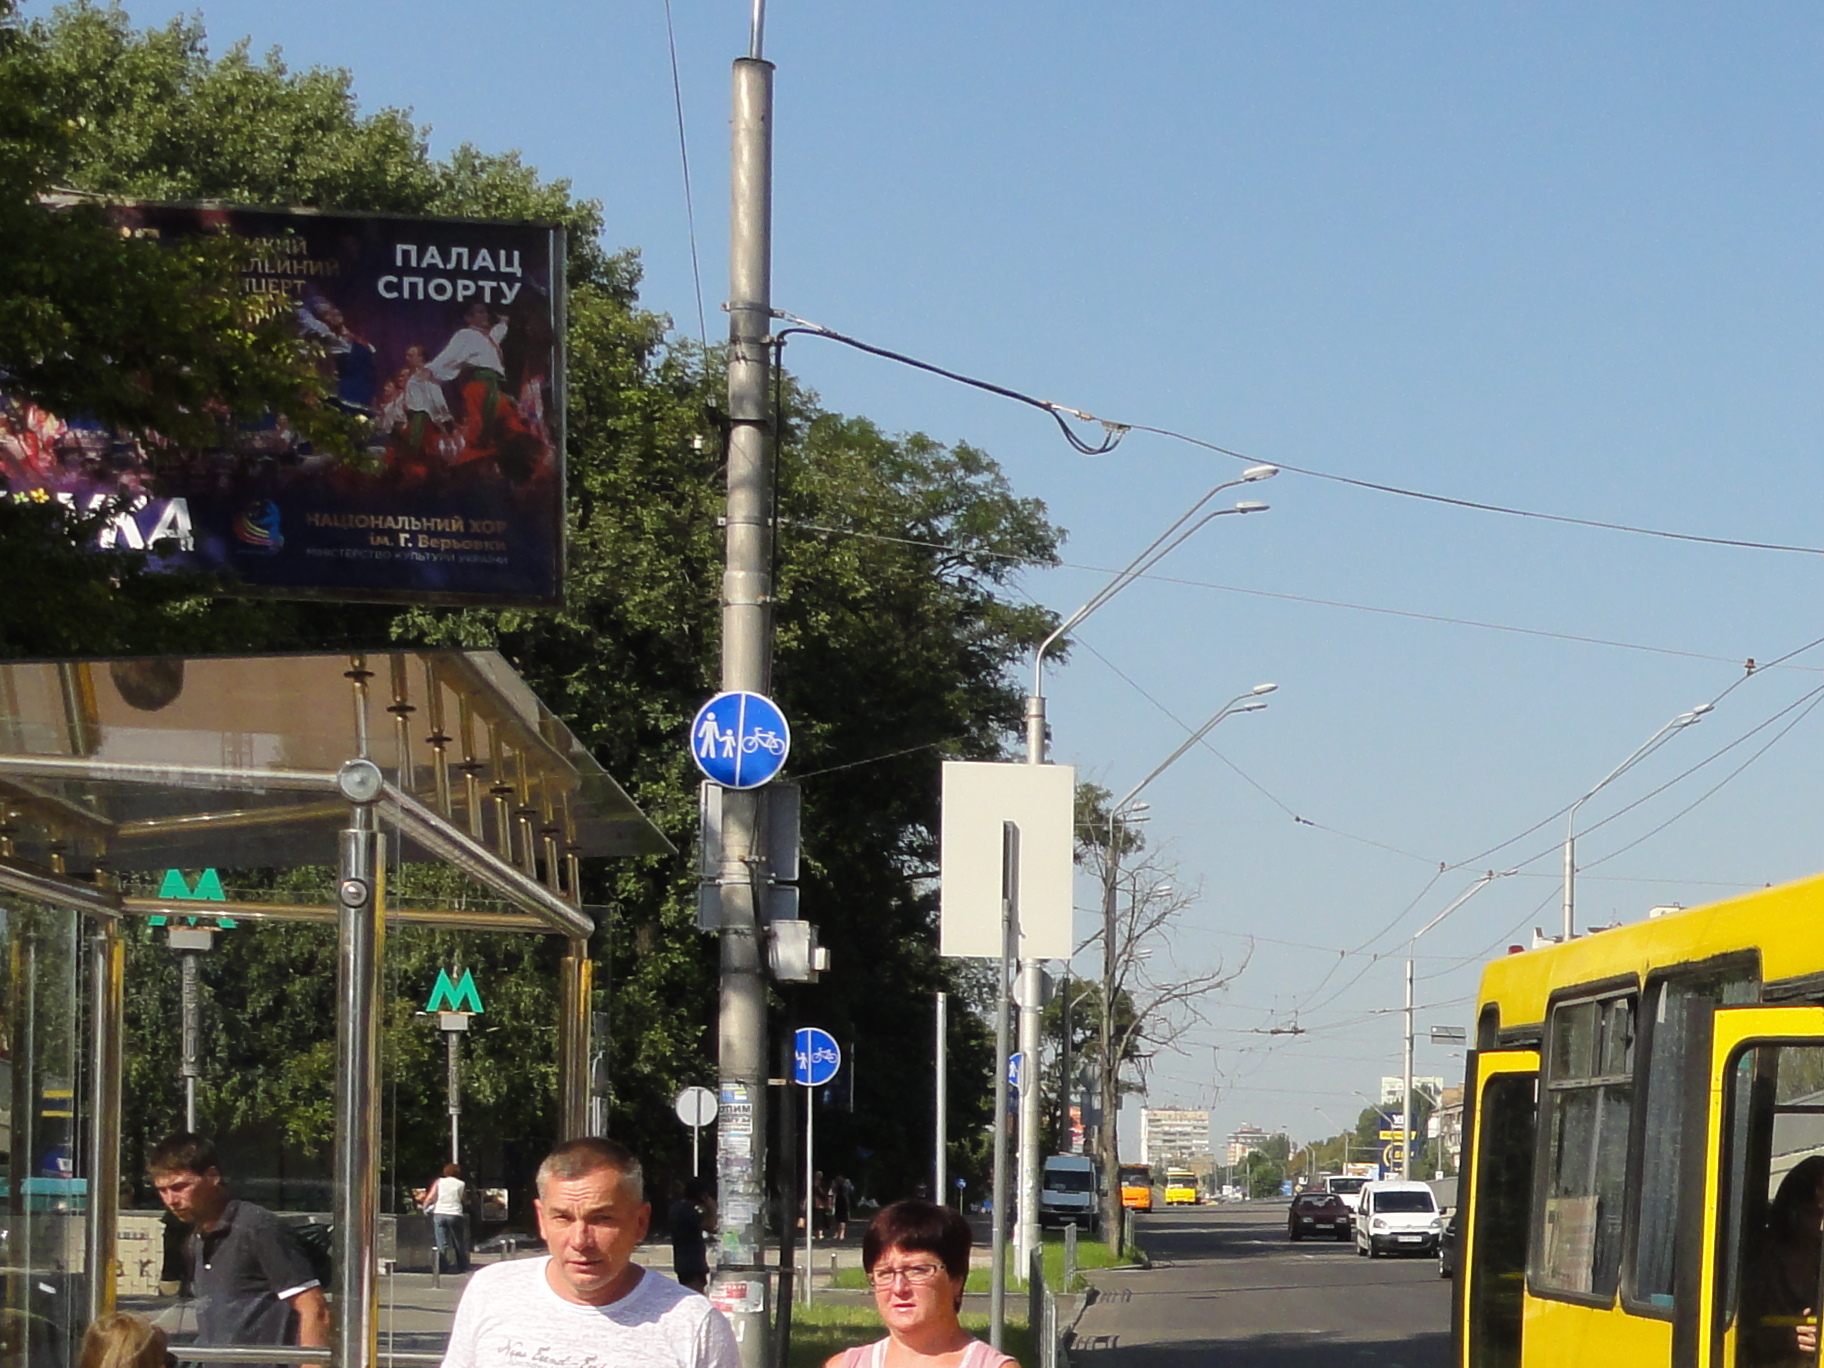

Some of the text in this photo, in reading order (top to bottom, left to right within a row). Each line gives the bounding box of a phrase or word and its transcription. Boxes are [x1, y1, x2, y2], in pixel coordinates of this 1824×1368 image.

[395, 243, 522, 275] ПАЛАЦ
[377, 274, 522, 305] СПОРТУ
[306, 512, 465, 533] НАЦІОНАЛЬНИЙ
[369, 532, 394, 547] ім.
[399, 532, 413, 548] Г.
